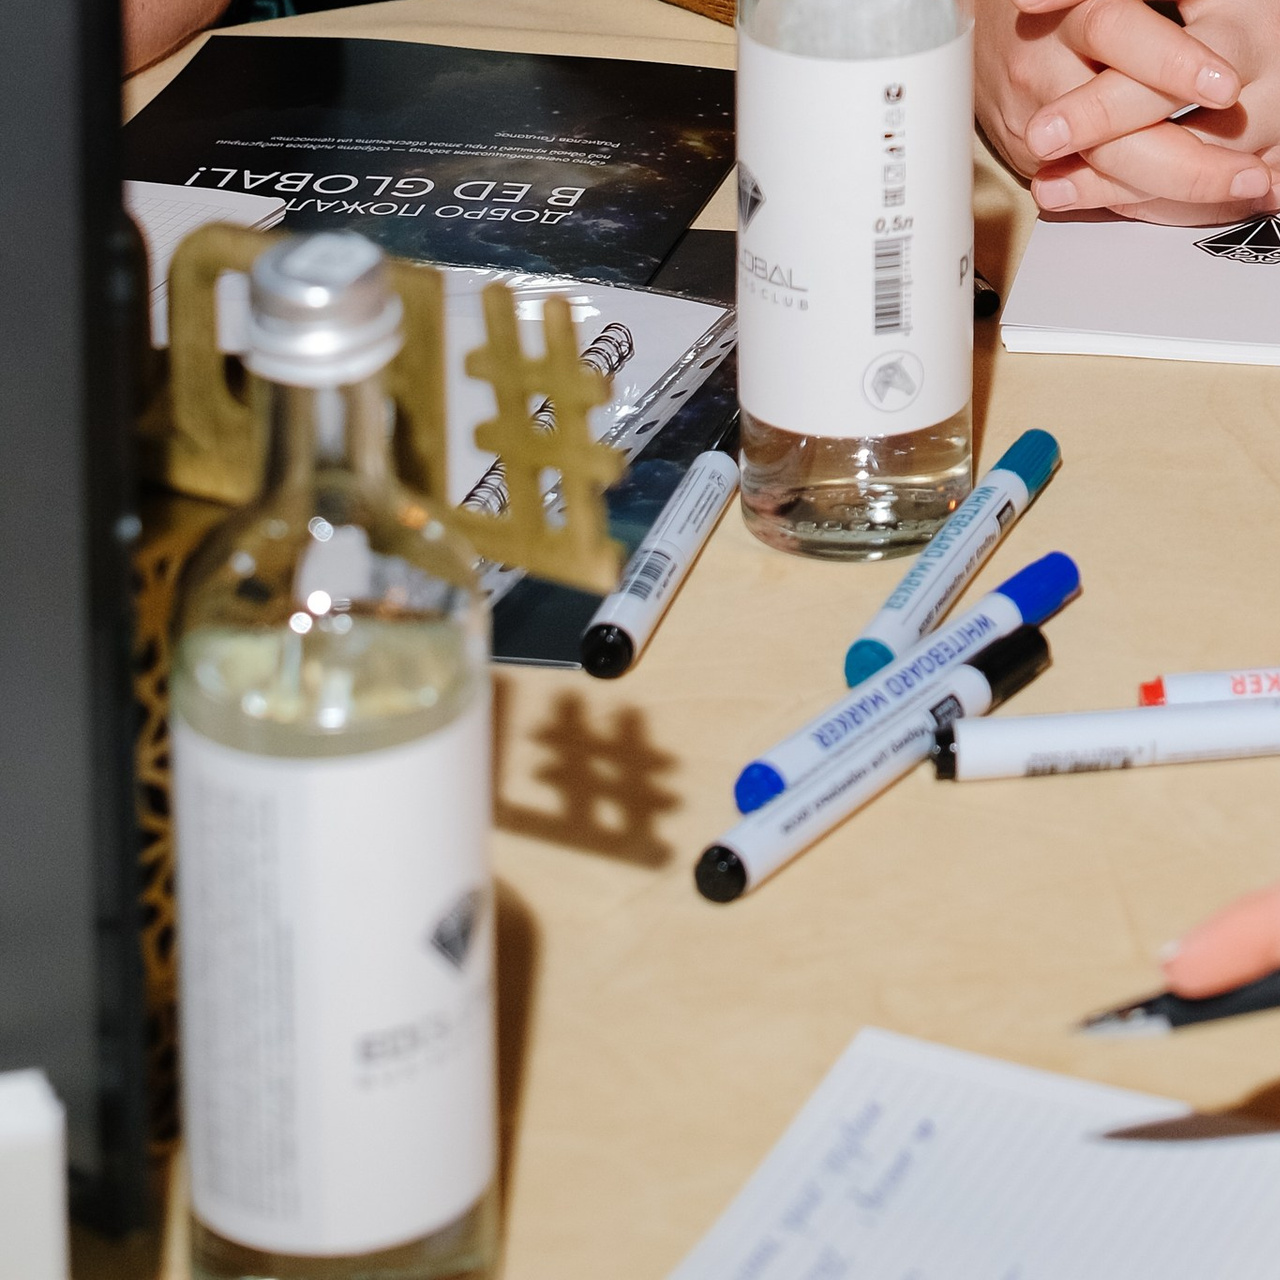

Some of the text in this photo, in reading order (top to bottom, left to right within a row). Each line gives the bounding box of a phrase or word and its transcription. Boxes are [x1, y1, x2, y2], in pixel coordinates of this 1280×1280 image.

[184, 166, 435, 198] GLOBAL!
[453, 180, 532, 203] ED
[434, 205, 574, 225] ДОБРО
[885, 485, 998, 610] WHITEBOARD MARKER
[884, 613, 998, 697] WHITEBOARD
[811, 689, 890, 750] MARKER
